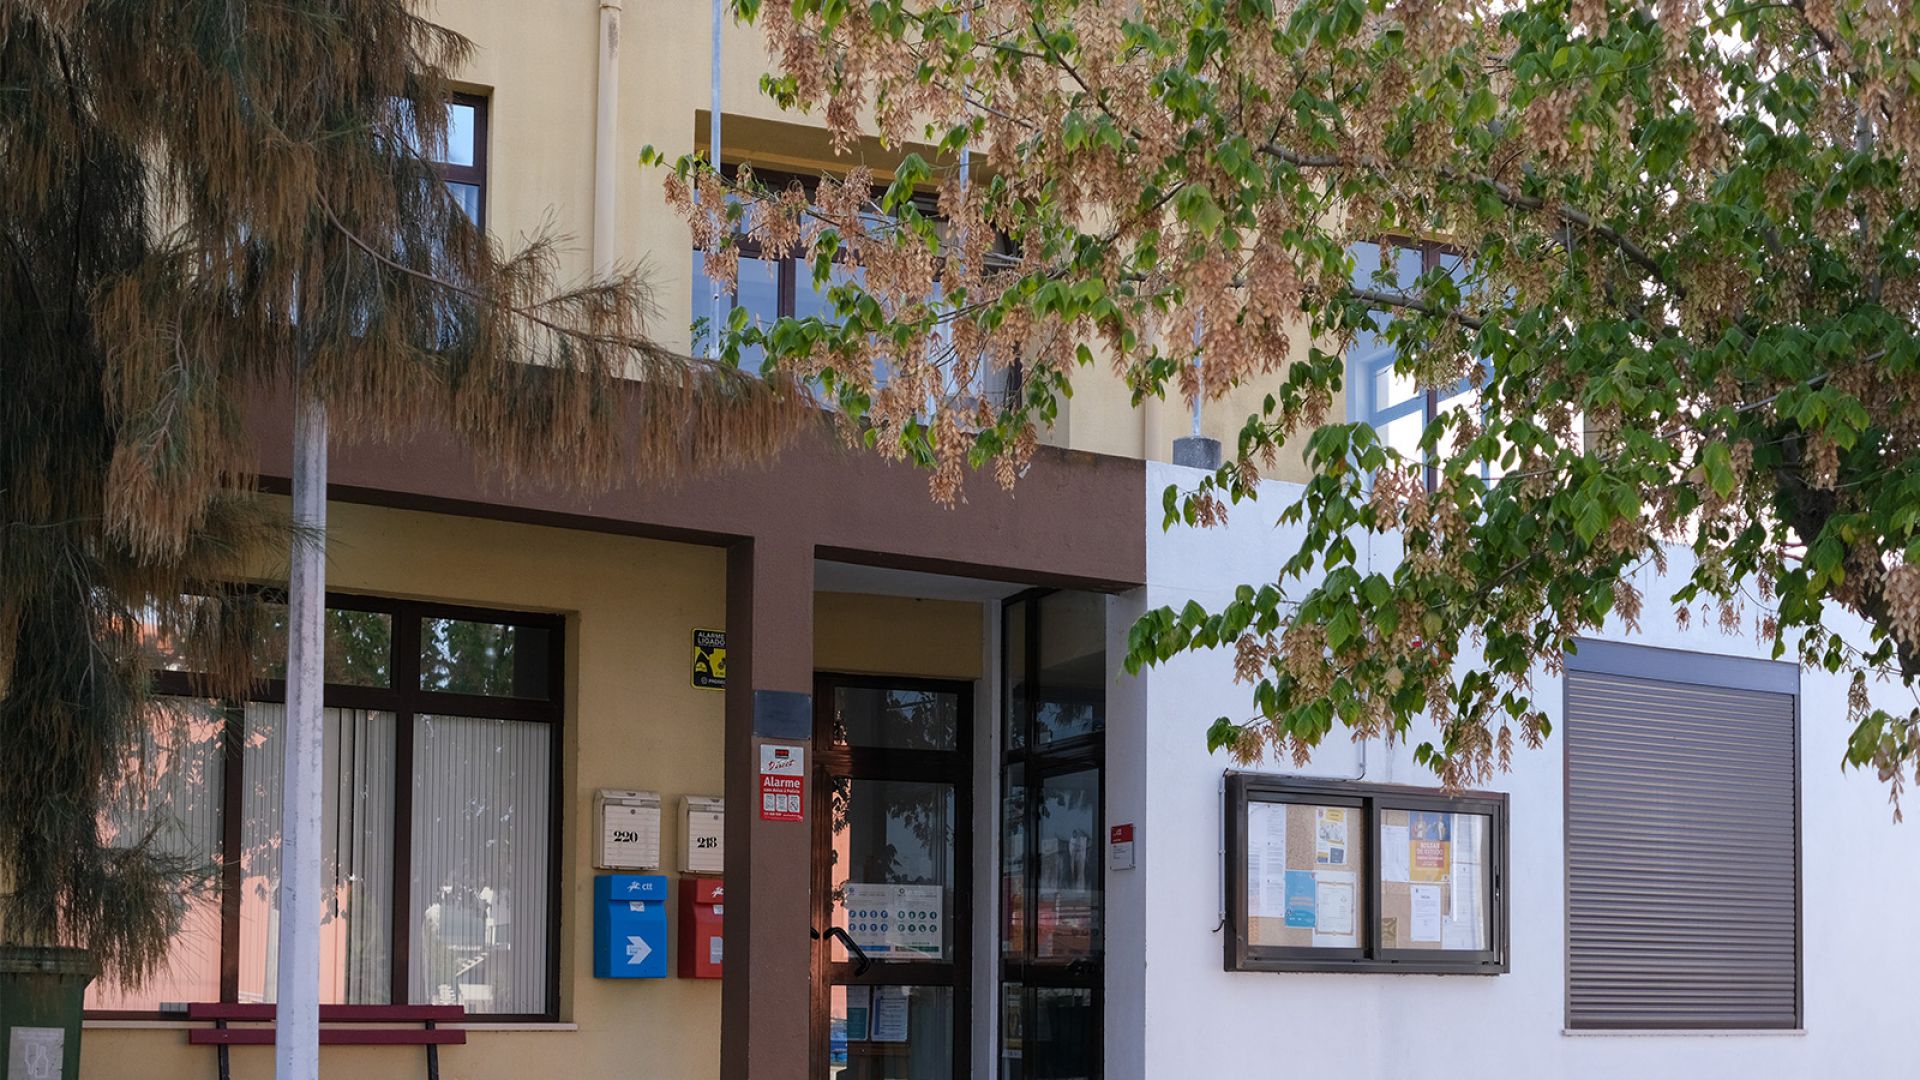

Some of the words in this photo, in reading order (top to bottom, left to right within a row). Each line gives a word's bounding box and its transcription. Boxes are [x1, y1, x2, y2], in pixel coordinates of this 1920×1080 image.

[698, 637, 726, 645] LIGADO
[763, 777, 800, 788] Alarme
[613, 831, 638, 843] 220
